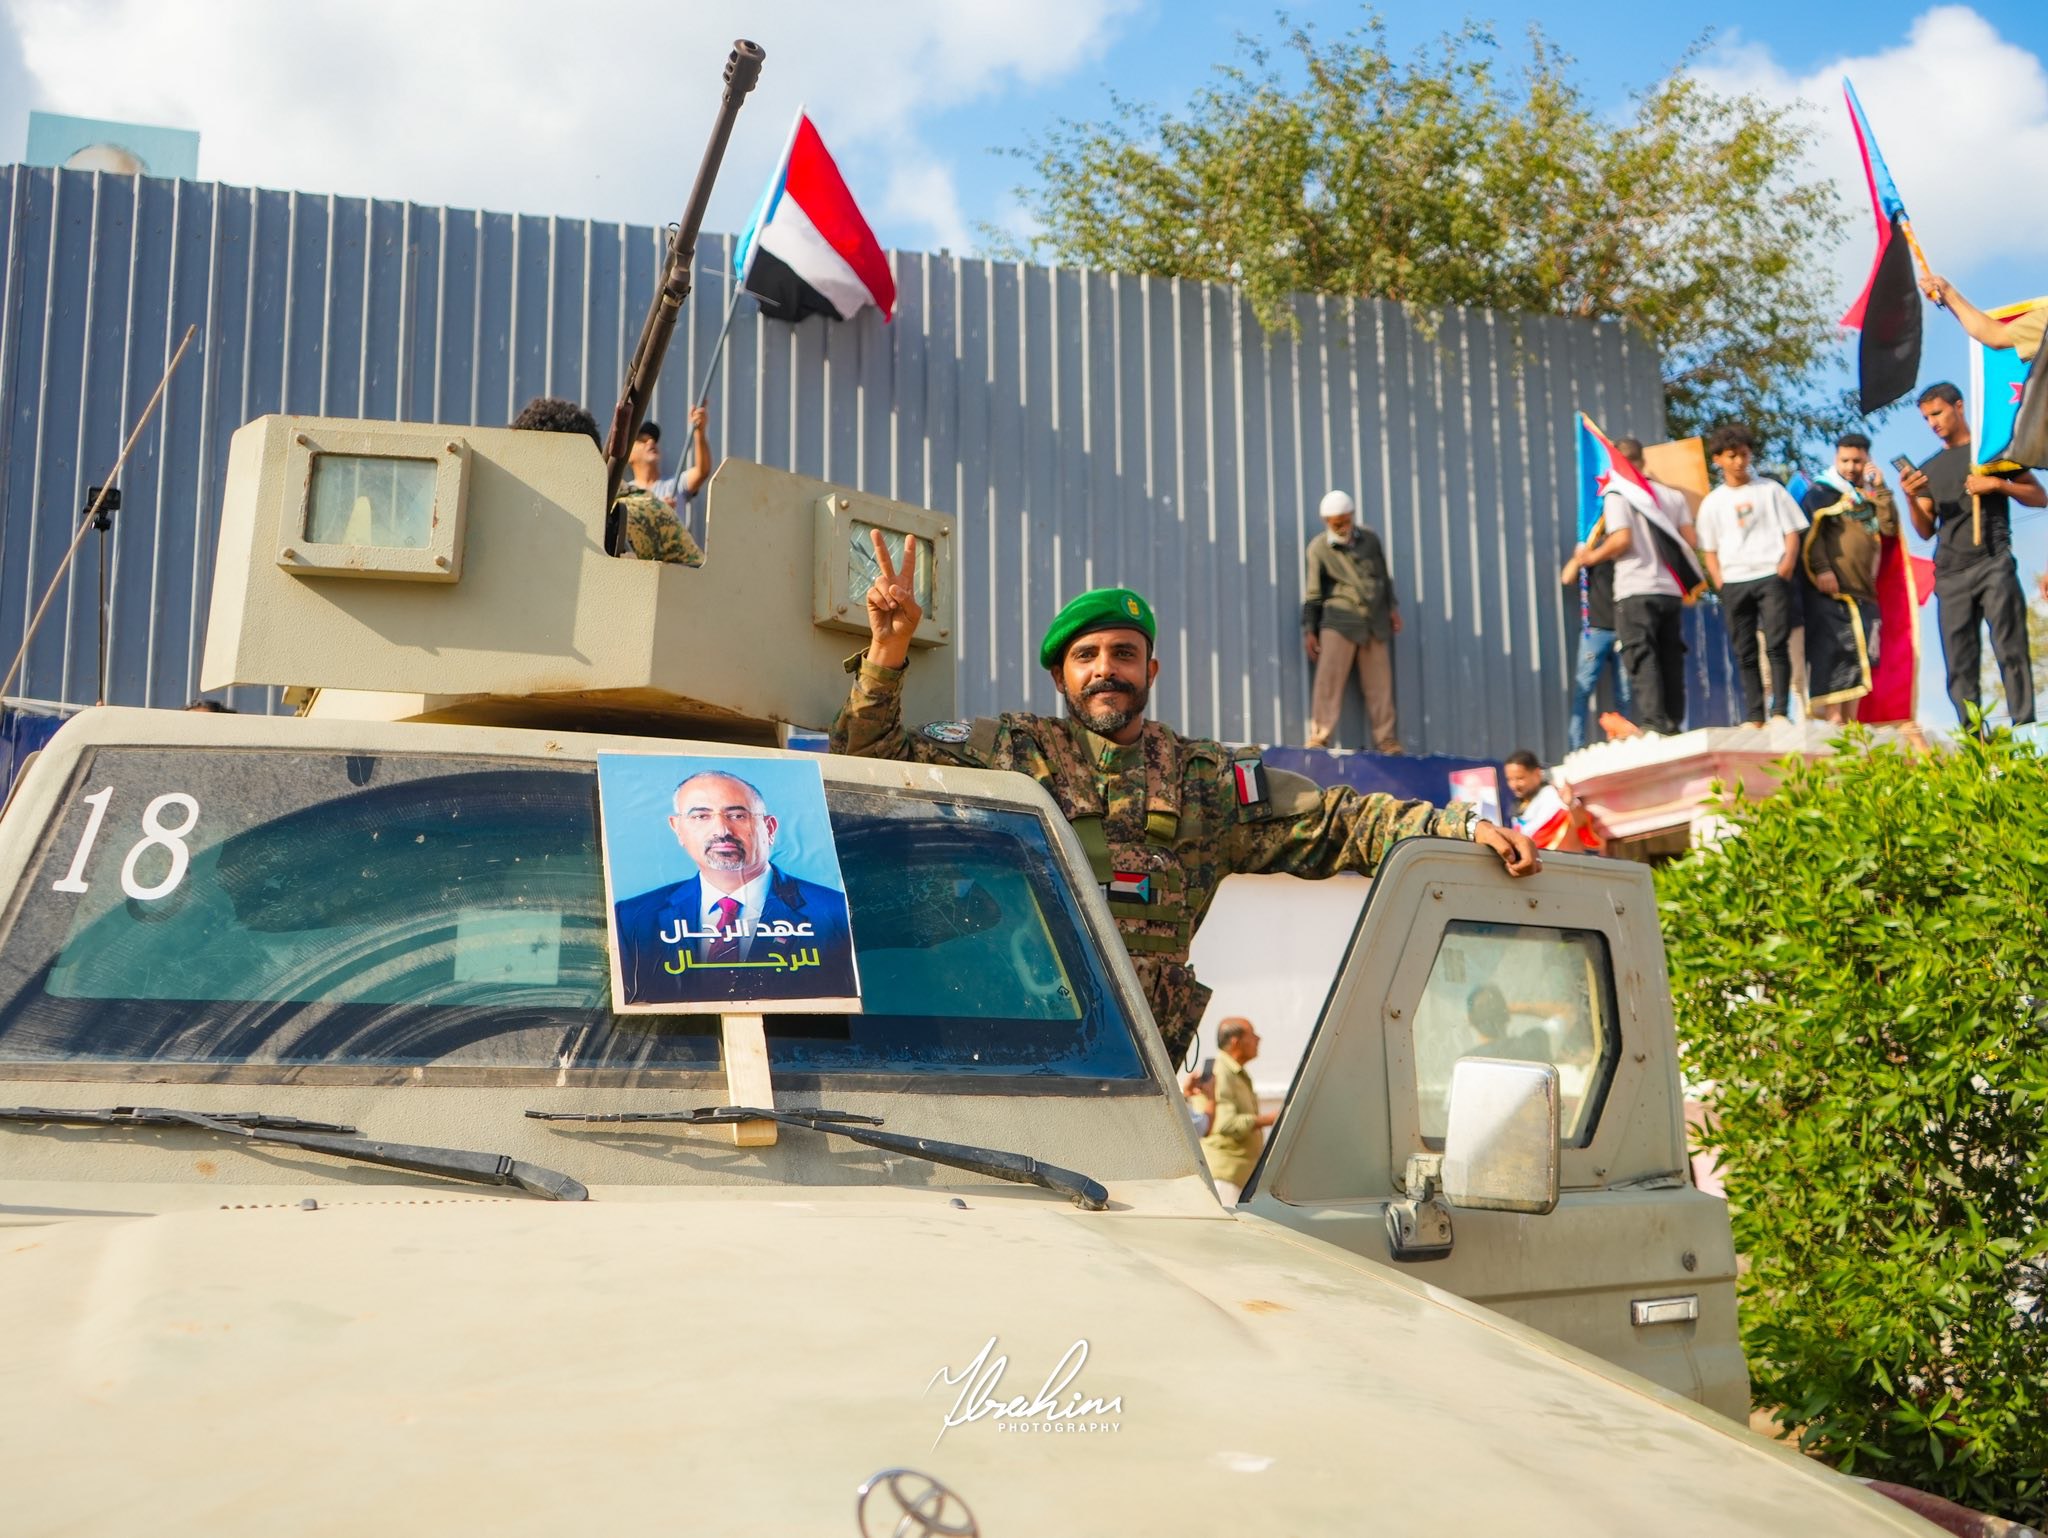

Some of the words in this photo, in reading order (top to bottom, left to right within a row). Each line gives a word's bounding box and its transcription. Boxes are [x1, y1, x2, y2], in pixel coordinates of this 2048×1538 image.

[52, 786, 199, 900] 18
[660, 919, 749, 943] الرجال
[756, 919, 814, 937] عهد
[664, 948, 820, 975] للرجال
